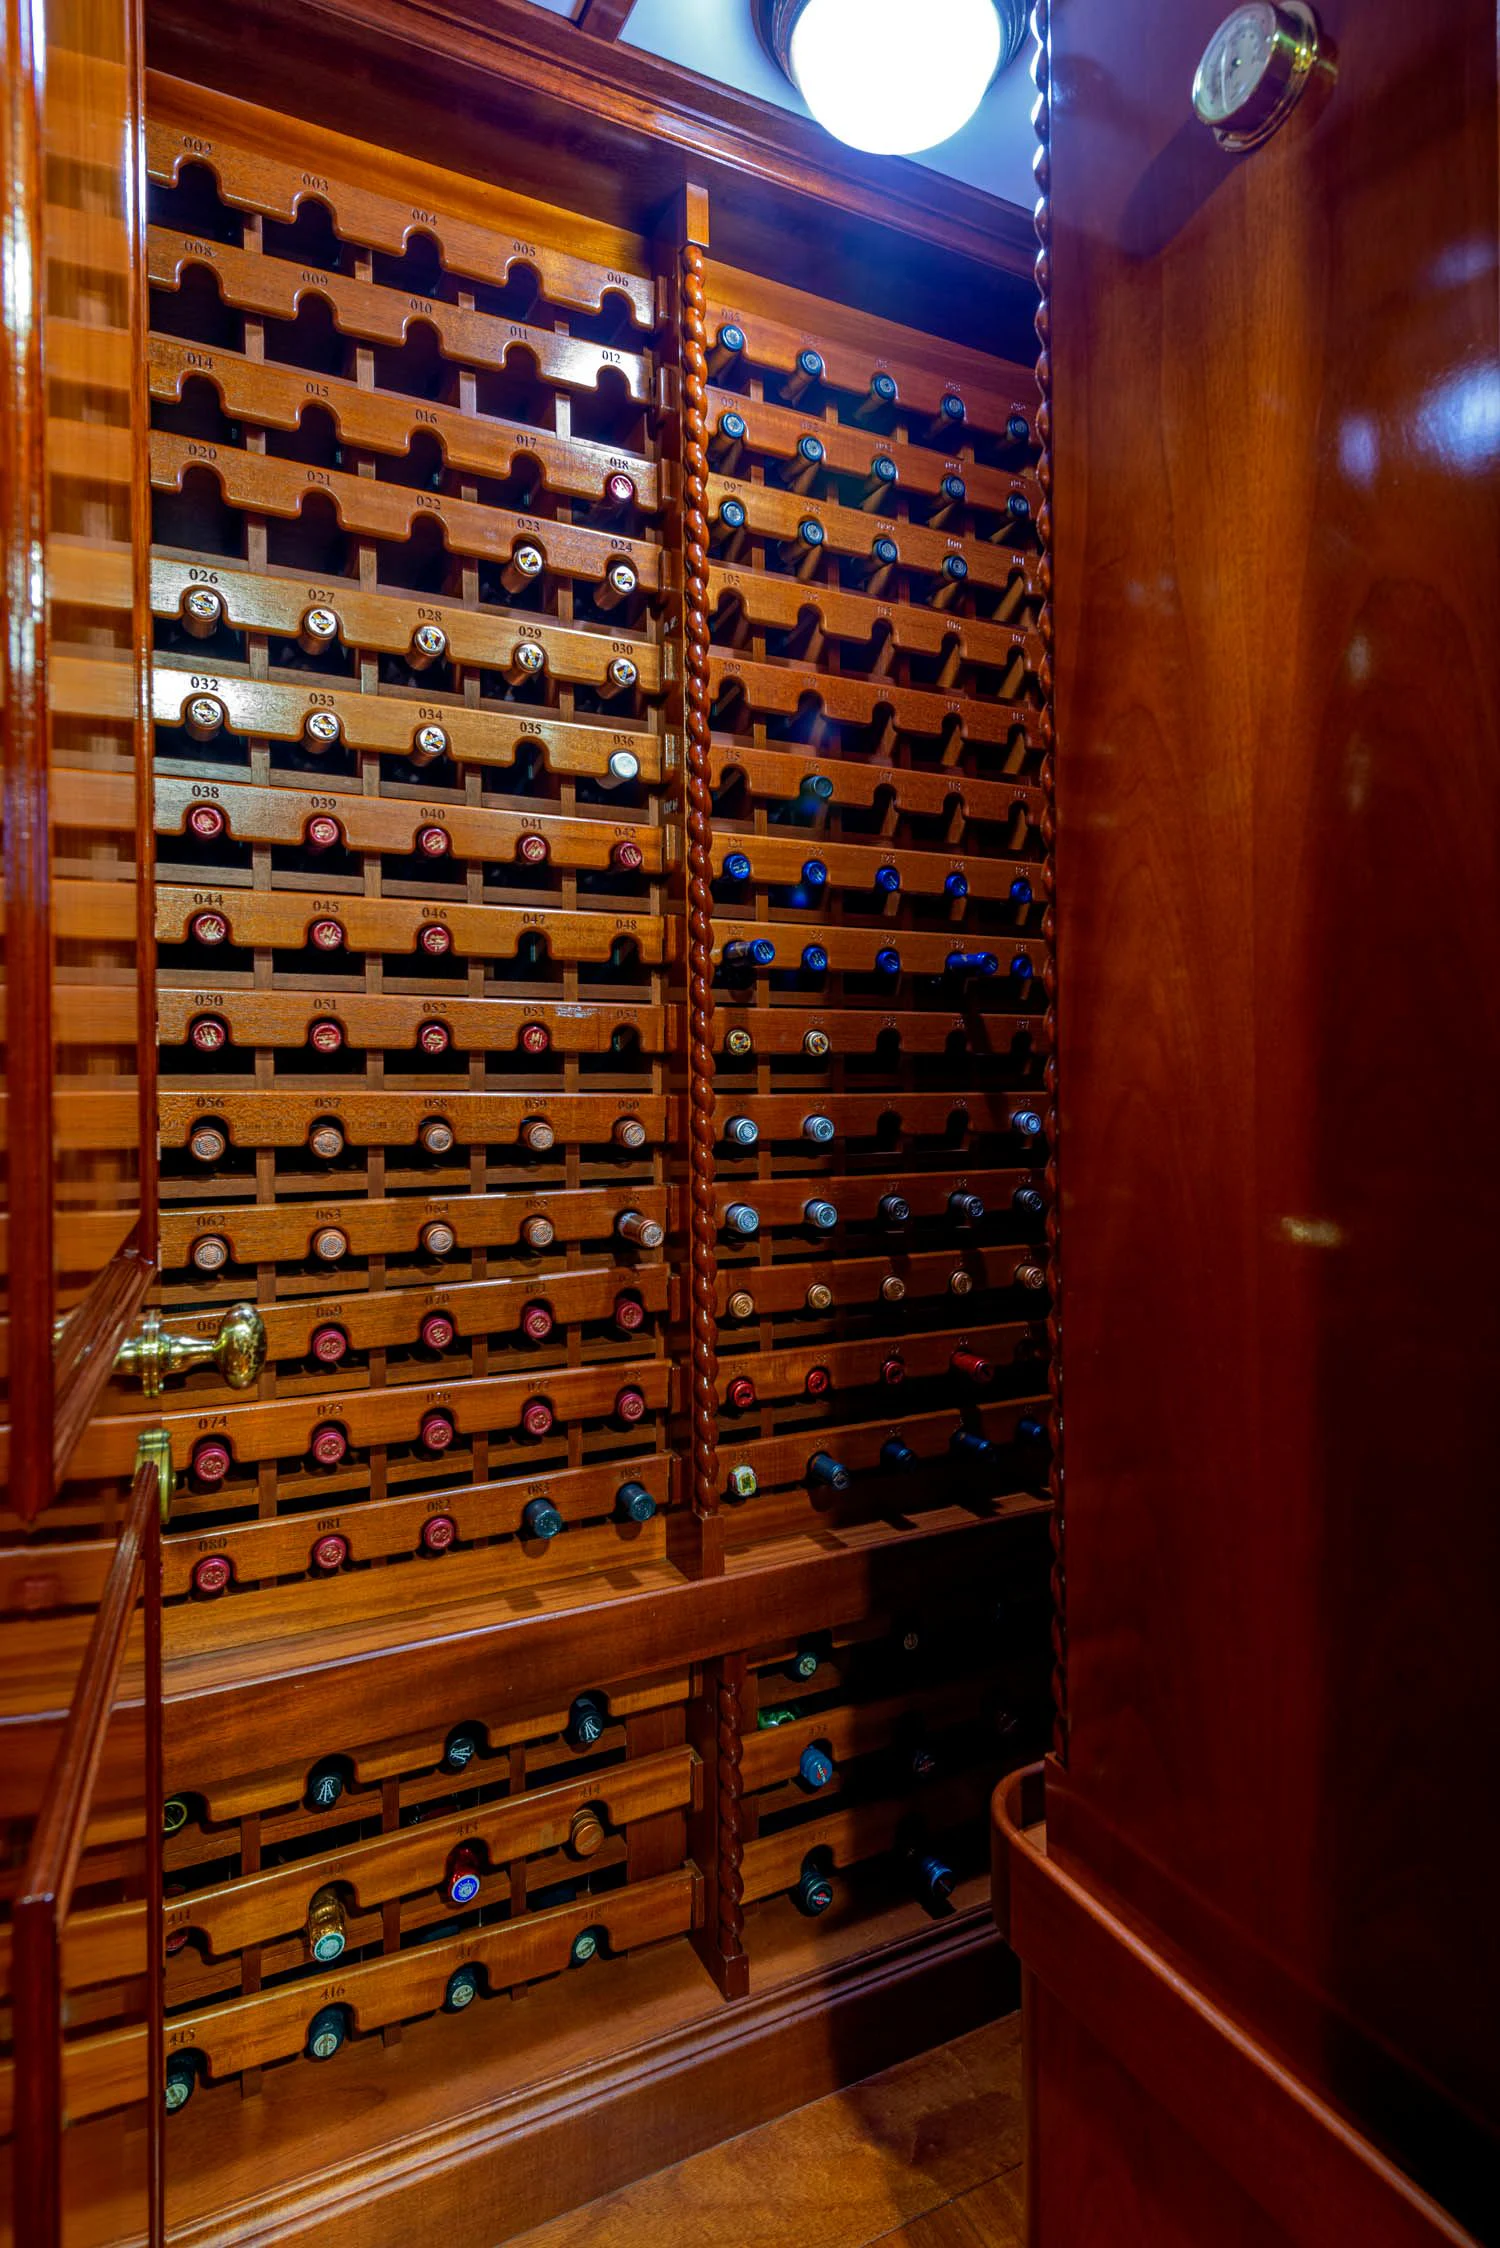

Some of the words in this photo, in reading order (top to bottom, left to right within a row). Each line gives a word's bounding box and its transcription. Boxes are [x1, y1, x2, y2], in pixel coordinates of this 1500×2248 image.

[183, 136, 211, 153] 002
[302, 173, 329, 191] 003
[412, 209, 437, 226] 004
[184, 240, 212, 257] 008
[513, 242, 535, 257] 005
[302, 271, 328, 285] 009
[607, 272, 629, 287] 006
[410, 299, 432, 313] 010
[510, 326, 528, 340] 011
[187, 351, 213, 369] 014
[602, 351, 621, 364] 012
[306, 383, 329, 397] 015
[415, 411, 438, 424] 016
[516, 435, 536, 448] 017
[189, 444, 216, 460] 020
[610, 457, 629, 470] 018
[307, 471, 330, 487] 021
[724, 480, 743, 493] 097
[416, 494, 441, 510] 022
[517, 518, 539, 533] 023
[611, 539, 632, 552] 024
[190, 569, 218, 584] 026
[308, 589, 334, 604] 027
[418, 608, 441, 621] 028
[519, 625, 541, 639] 029
[612, 642, 633, 655] 030
[191, 677, 218, 691] 032
[309, 693, 334, 706] 033
[419, 708, 443, 720] 034
[520, 721, 541, 734] 035
[613, 734, 634, 746] 036
[192, 785, 219, 799] 038
[311, 796, 336, 809] 039
[420, 807, 445, 820] 040
[521, 817, 542, 830] 041
[614, 827, 636, 839] 042
[194, 893, 222, 906] 044
[313, 900, 339, 912] 045
[422, 907, 447, 919] 046
[523, 914, 545, 924] 047
[616, 919, 637, 930] 048
[195, 995, 223, 1006] 050
[314, 999, 337, 1010] 051
[422, 1002, 447, 1013] 052
[523, 1006, 544, 1017] 053
[196, 1097, 224, 1109] 056
[315, 1098, 339, 1108] 057
[424, 1098, 448, 1109] 058
[524, 1100, 547, 1110] 059
[197, 1215, 225, 1227] 062
[316, 1304, 343, 1317] 069
[317, 1403, 343, 1417] 075
[199, 1416, 227, 1429] 074
[427, 1500, 450, 1513] 082
[317, 1518, 340, 1531] 081
[200, 1539, 227, 1552] 080
[168, 1910, 190, 1925] 411
[321, 1984, 345, 2000] 416
[170, 2030, 195, 2046] 415
